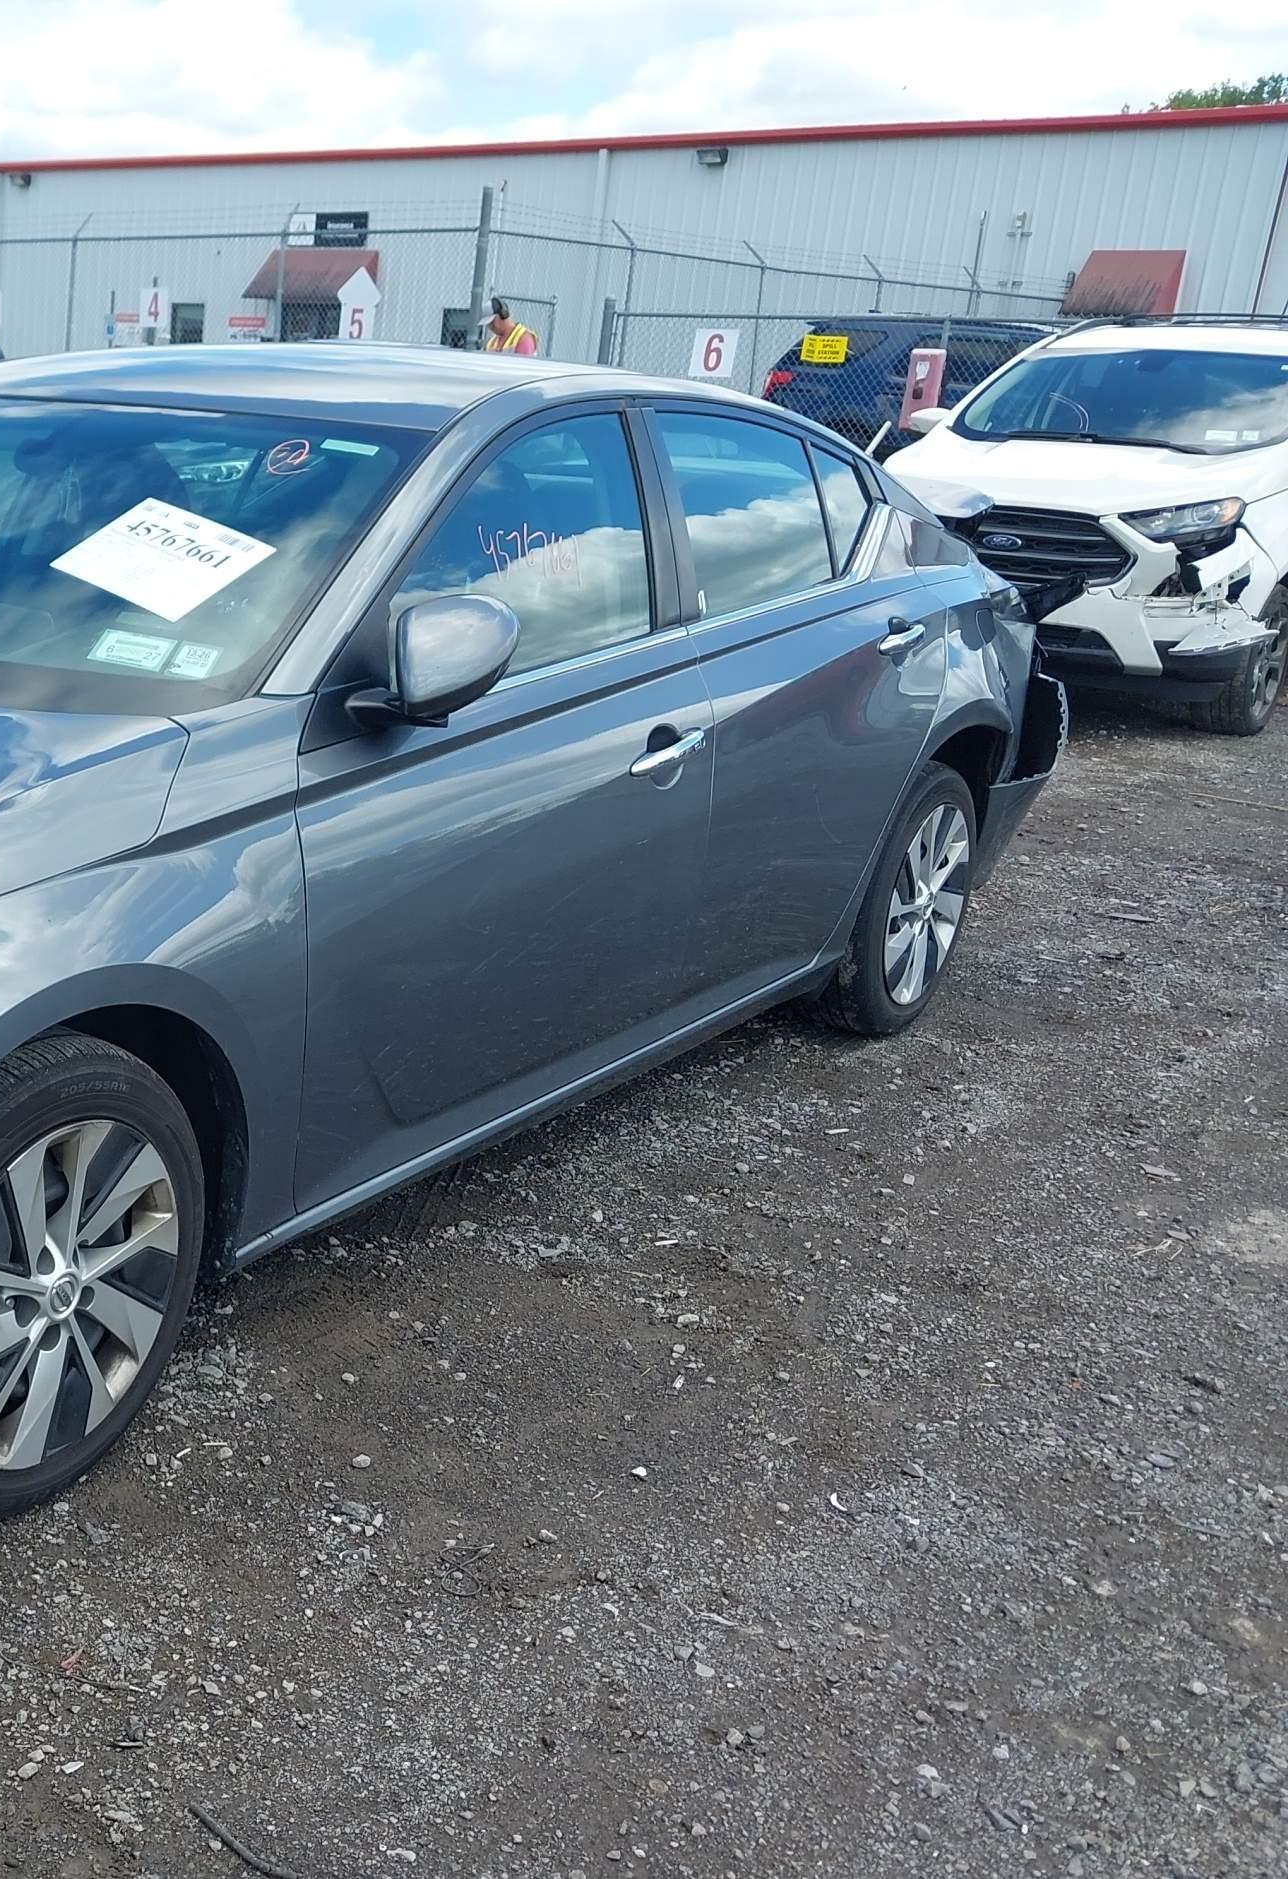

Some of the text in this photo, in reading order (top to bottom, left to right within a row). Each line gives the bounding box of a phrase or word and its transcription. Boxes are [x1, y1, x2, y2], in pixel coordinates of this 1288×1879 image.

[148, 292, 159, 323] 4
[349, 308, 364, 339] 5
[703, 333, 724, 372] 6
[126, 520, 232, 568] 45767661
[143, 651, 161, 661] 27
